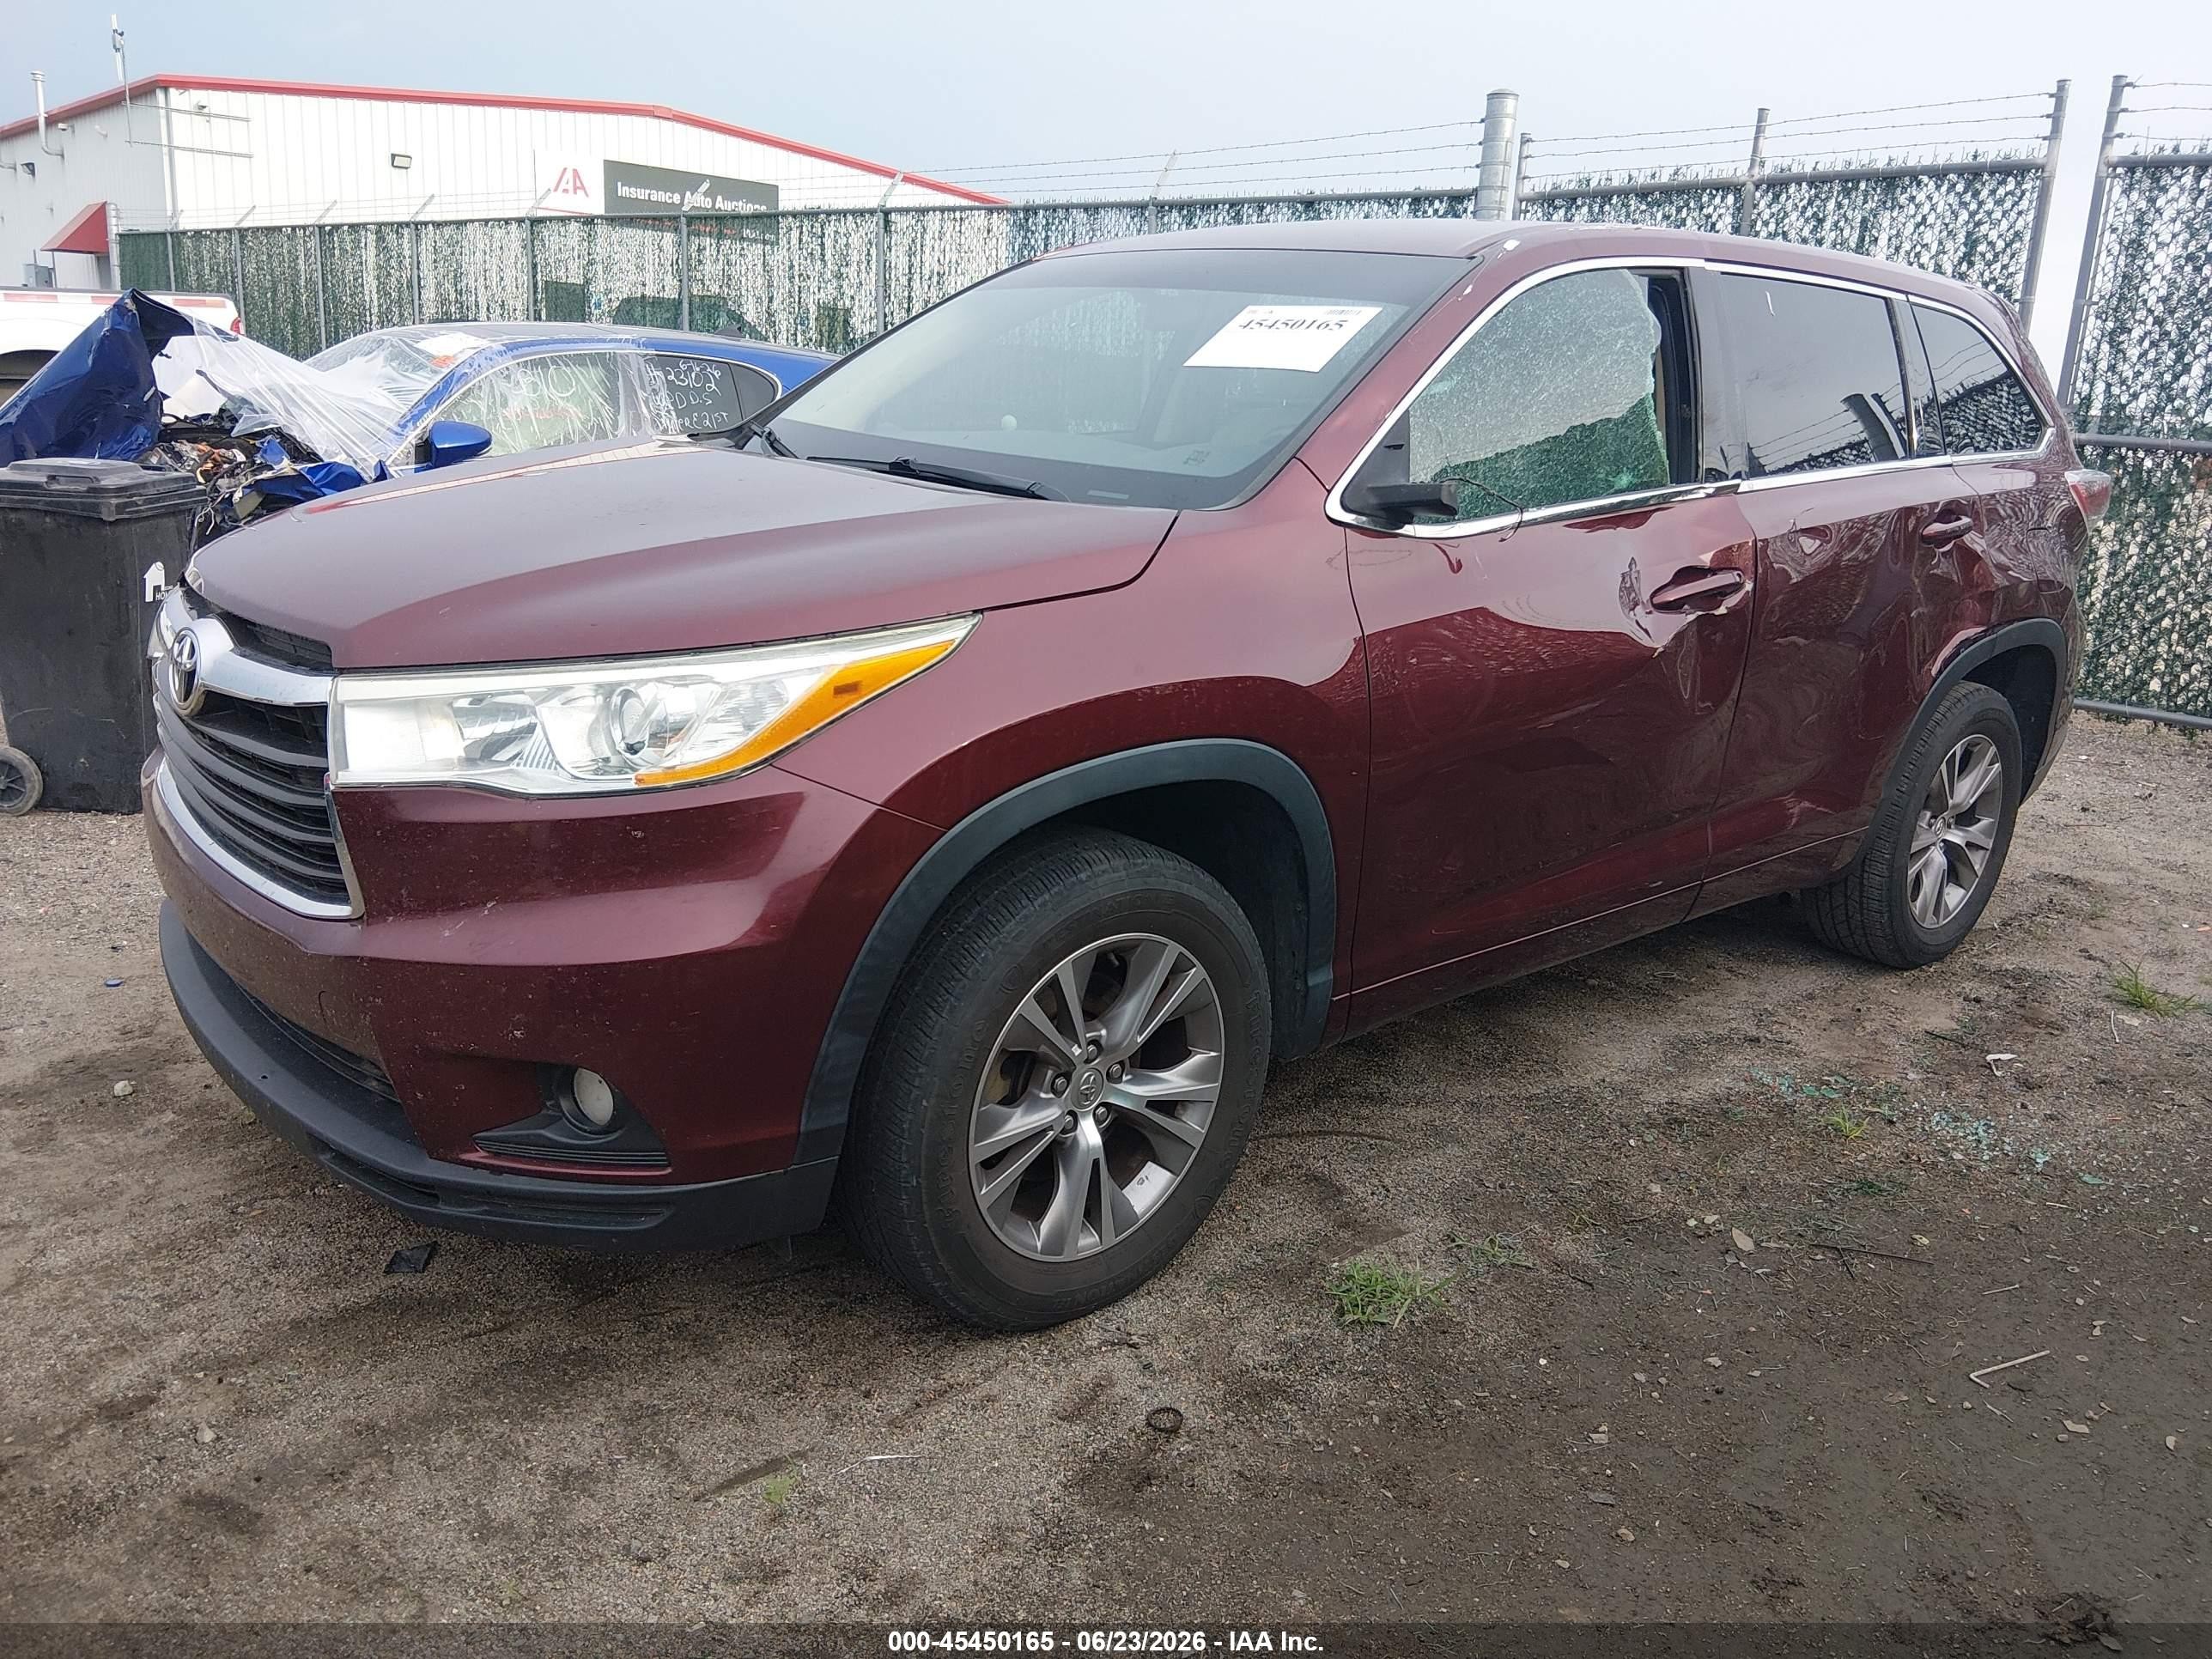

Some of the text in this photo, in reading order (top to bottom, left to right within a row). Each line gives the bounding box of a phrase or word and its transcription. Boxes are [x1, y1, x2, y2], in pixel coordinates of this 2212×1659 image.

[617, 181, 681, 205] Insurance
[684, 190, 713, 210] Auto
[1239, 319, 1348, 331] 45450165
